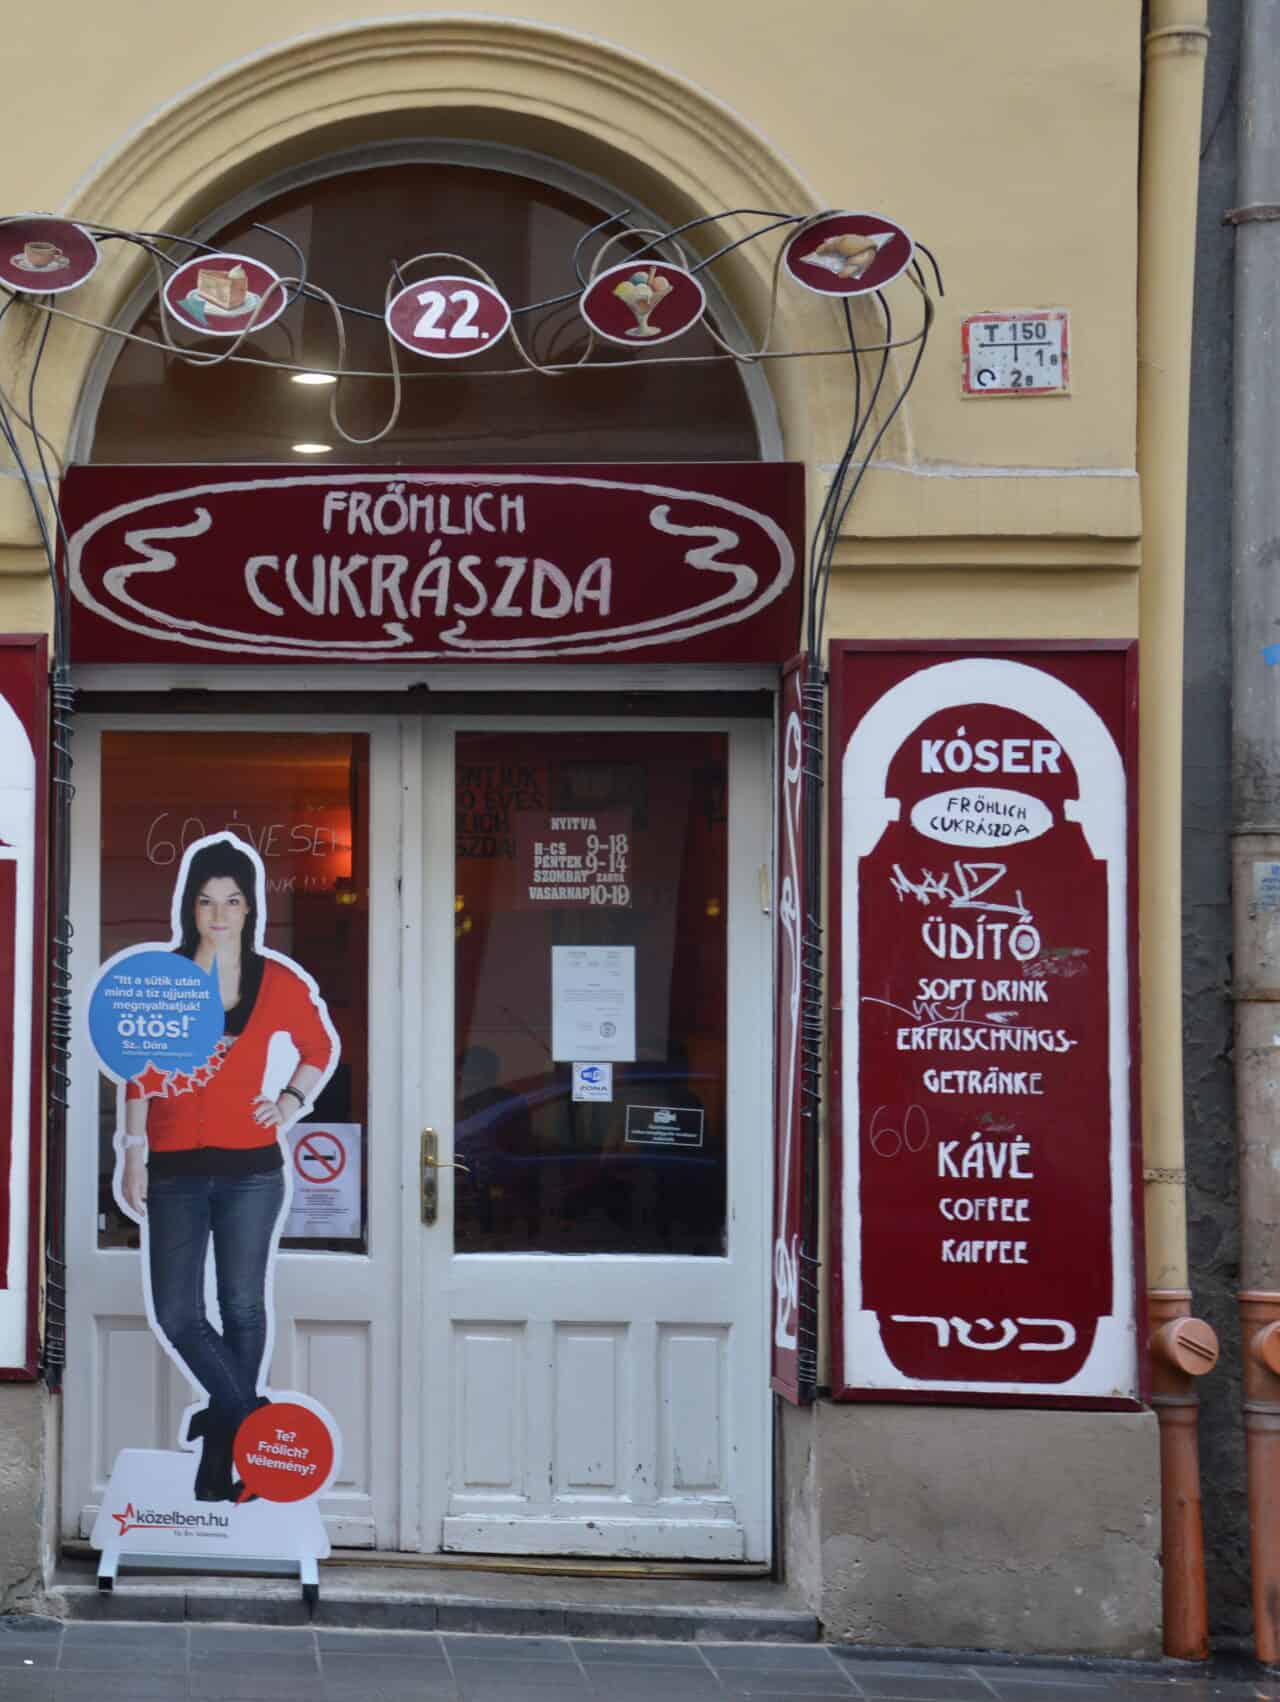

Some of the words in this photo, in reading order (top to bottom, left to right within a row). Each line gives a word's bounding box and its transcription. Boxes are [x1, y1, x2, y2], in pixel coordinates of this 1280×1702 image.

[413, 289, 490, 340] 22.
[983, 323, 999, 342] T
[243, 539, 612, 619] CUKRÁSZDA
[920, 725, 1062, 774] KÓSER
[550, 817, 597, 832] NYITVA
[104, 987, 134, 998] mind
[915, 978, 976, 1001] SOFT
[981, 979, 1049, 1003] DRINK
[922, 1066, 1045, 1095] GETRÄNKE
[937, 1131, 1035, 1180] KÁVÉ
[938, 1197, 1031, 1222] COFFEE
[941, 1240, 1029, 1265] KAFFEE
[890, 1314, 1077, 1351] כשר
[274, 1428, 297, 1444] Te?
[136, 1509, 229, 1528] közelben.hu
